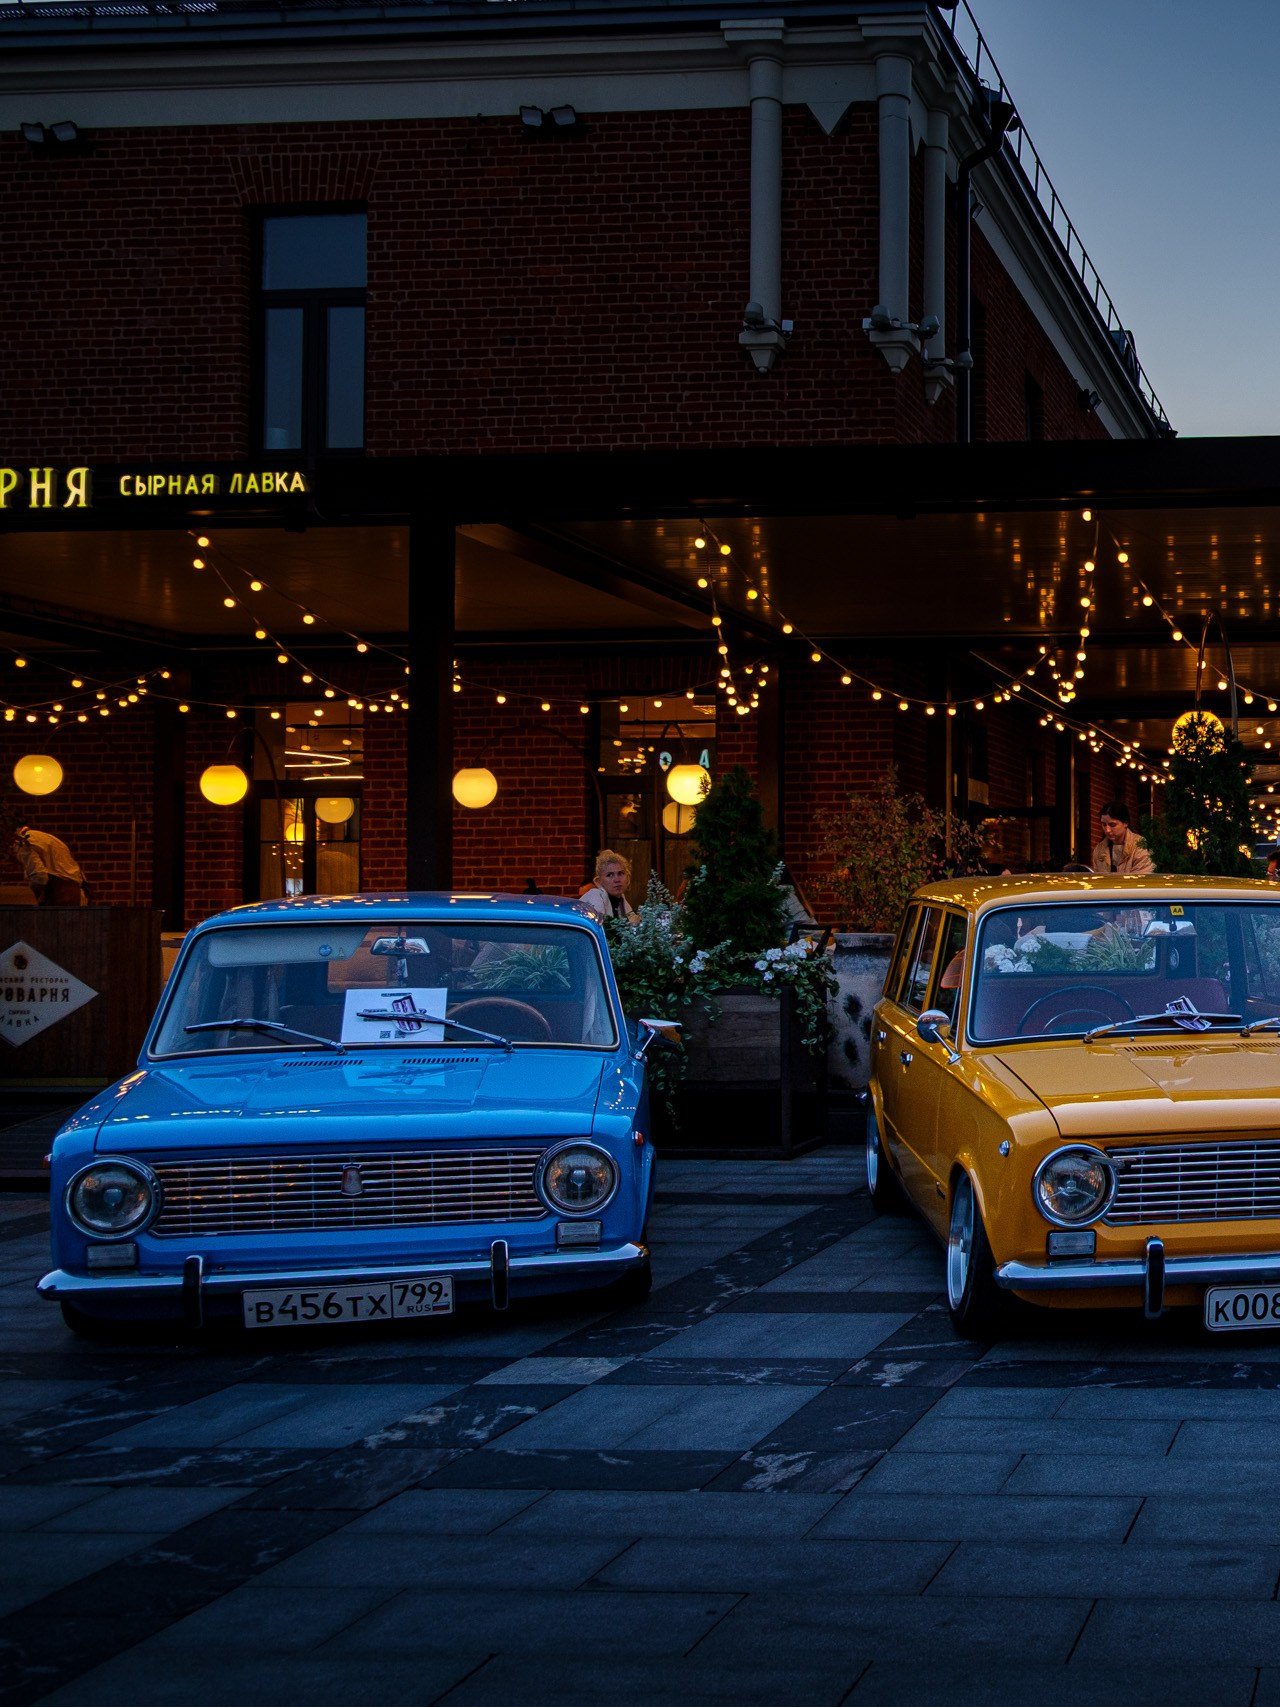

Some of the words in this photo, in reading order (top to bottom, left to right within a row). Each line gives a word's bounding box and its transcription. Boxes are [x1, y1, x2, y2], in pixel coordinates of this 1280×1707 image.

[0, 467, 90, 508] РНЯ
[119, 473, 215, 496] СЫРНАЯ
[229, 471, 306, 494] ЛАВКА
[255, 1291, 388, 1323] В456ТХ
[394, 1281, 444, 1306] 799
[407, 1303, 432, 1314] RUS
